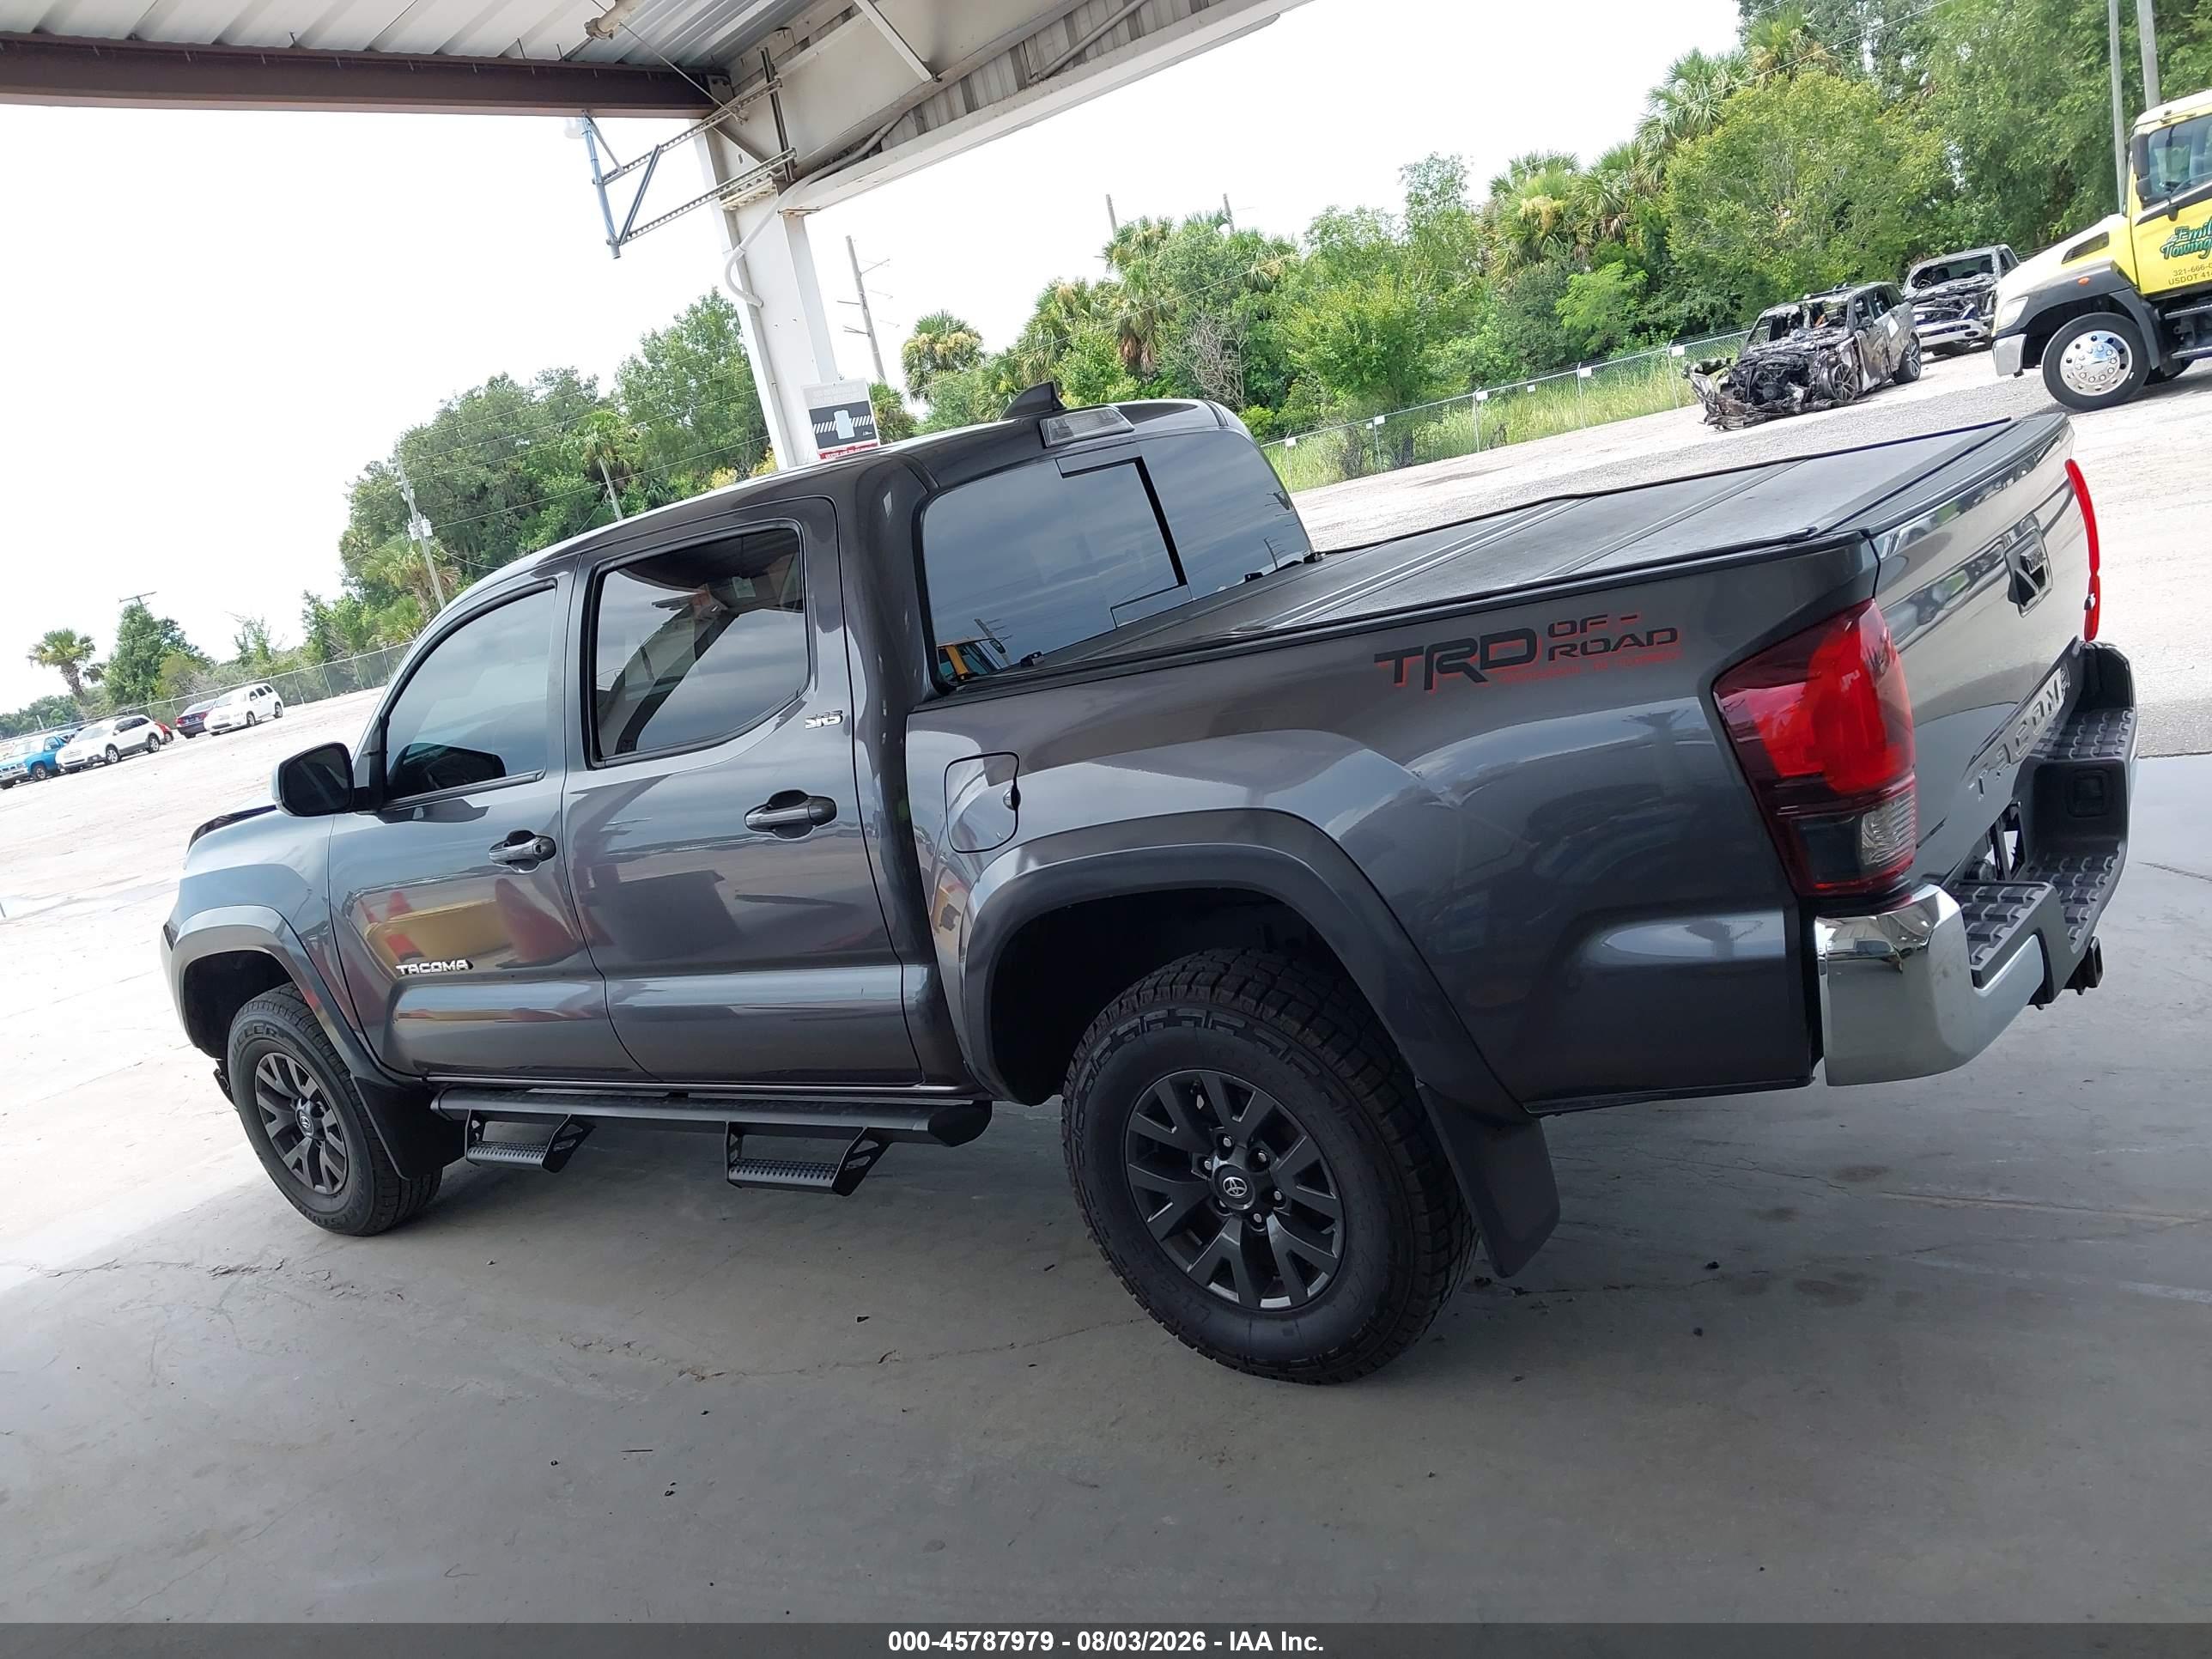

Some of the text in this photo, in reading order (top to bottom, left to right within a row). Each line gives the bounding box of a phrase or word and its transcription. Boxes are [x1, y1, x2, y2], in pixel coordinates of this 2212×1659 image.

[2160, 237, 2212, 259] Towing
[2168, 273, 2197, 285] USDOT
[1548, 627, 1680, 662] ROAD
[1374, 628, 1540, 692] TRD
[395, 959, 470, 975] TACOMA
